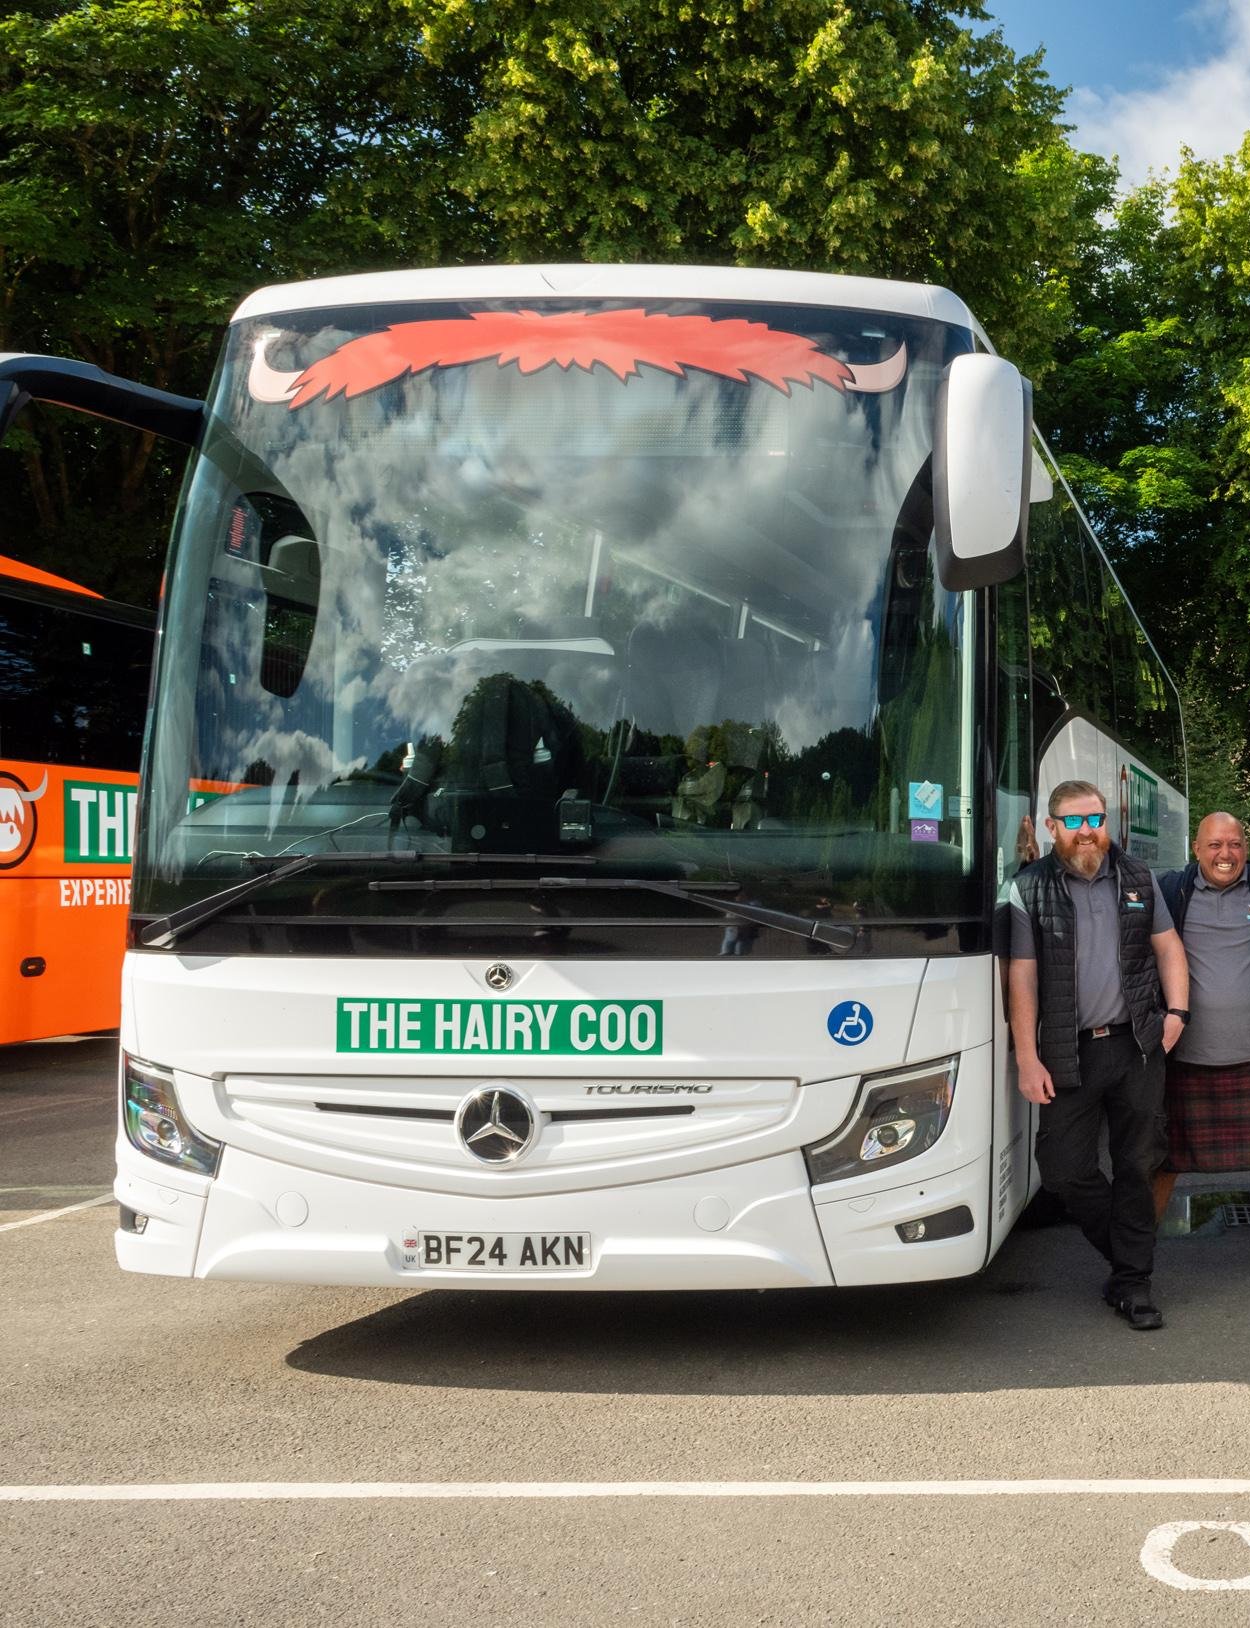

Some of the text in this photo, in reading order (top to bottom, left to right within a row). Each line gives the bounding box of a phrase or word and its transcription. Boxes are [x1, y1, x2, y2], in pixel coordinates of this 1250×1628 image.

[343, 1003, 656, 1051] THE HAIRY COO
[583, 1083, 712, 1095] TOURISMO
[405, 1255, 416, 1263] UK
[424, 1235, 583, 1266] BF24 AKN
